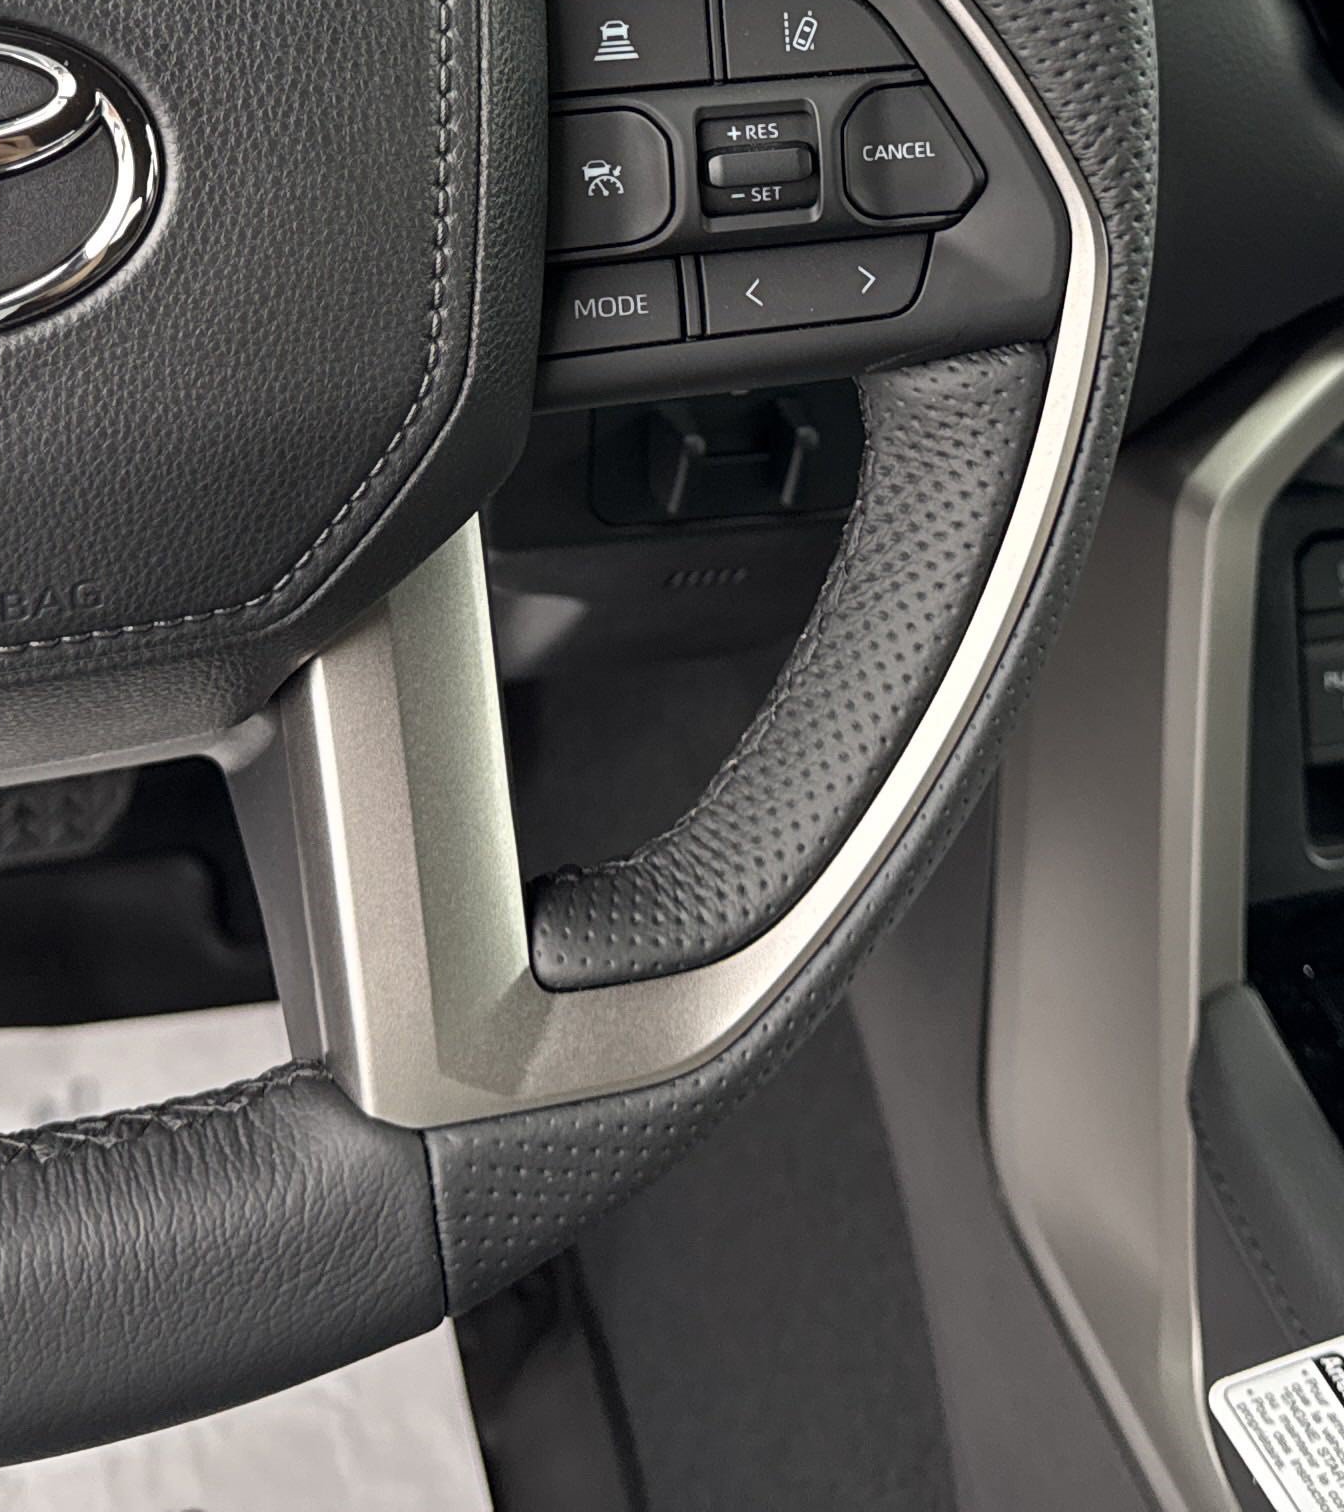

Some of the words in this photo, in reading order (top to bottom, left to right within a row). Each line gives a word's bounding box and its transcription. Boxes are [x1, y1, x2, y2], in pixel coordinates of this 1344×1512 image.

[744, 122, 780, 141] RES
[861, 140, 936, 163] CANCEL
[750, 185, 782, 203] SET
[574, 293, 650, 320] MODE
